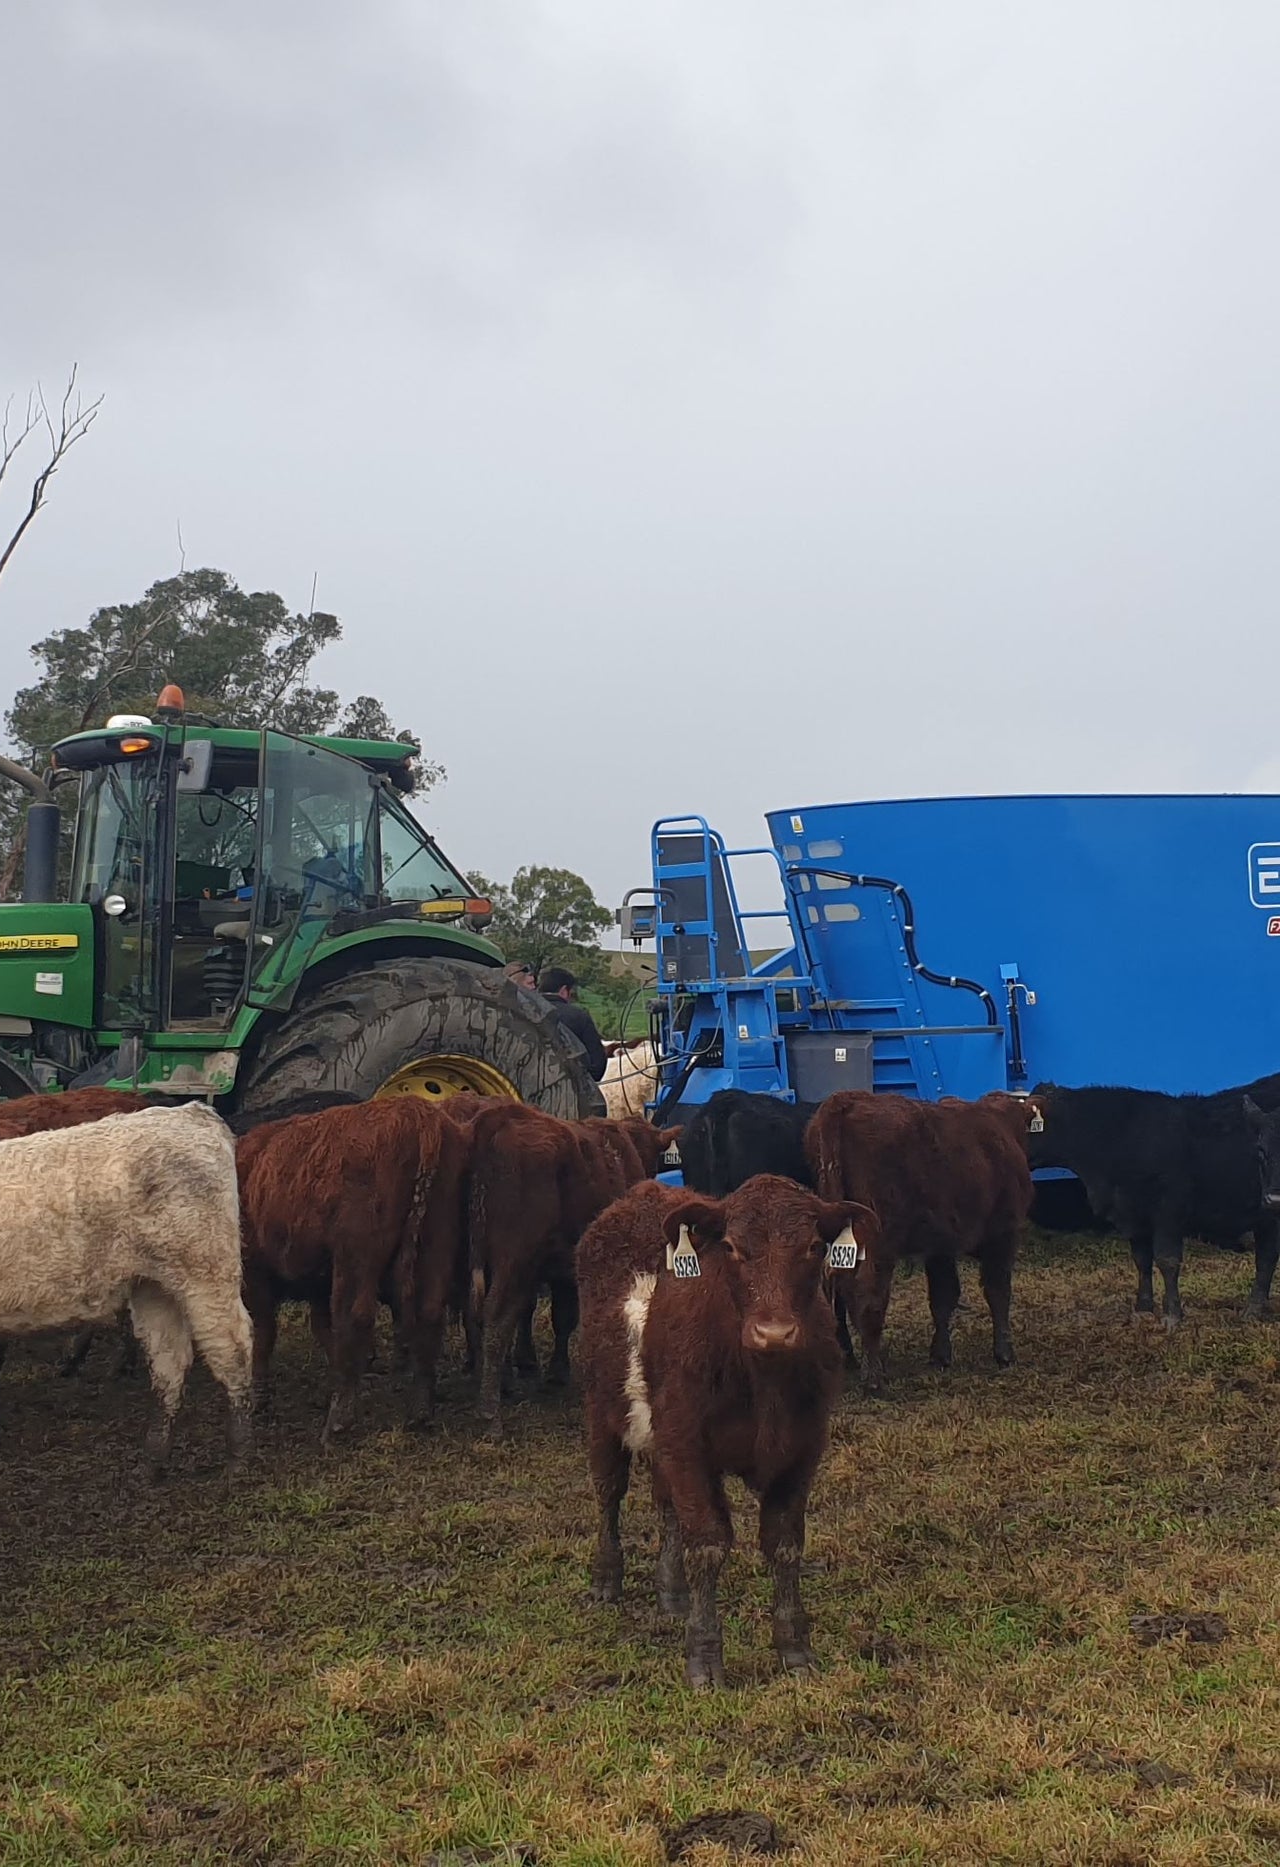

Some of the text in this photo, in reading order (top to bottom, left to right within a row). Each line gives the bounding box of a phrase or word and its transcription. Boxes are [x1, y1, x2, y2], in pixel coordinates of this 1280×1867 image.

[21, 938, 60, 948] DEERE
[674, 1254, 700, 1276] S5258
[831, 1245, 856, 1267] S5258
